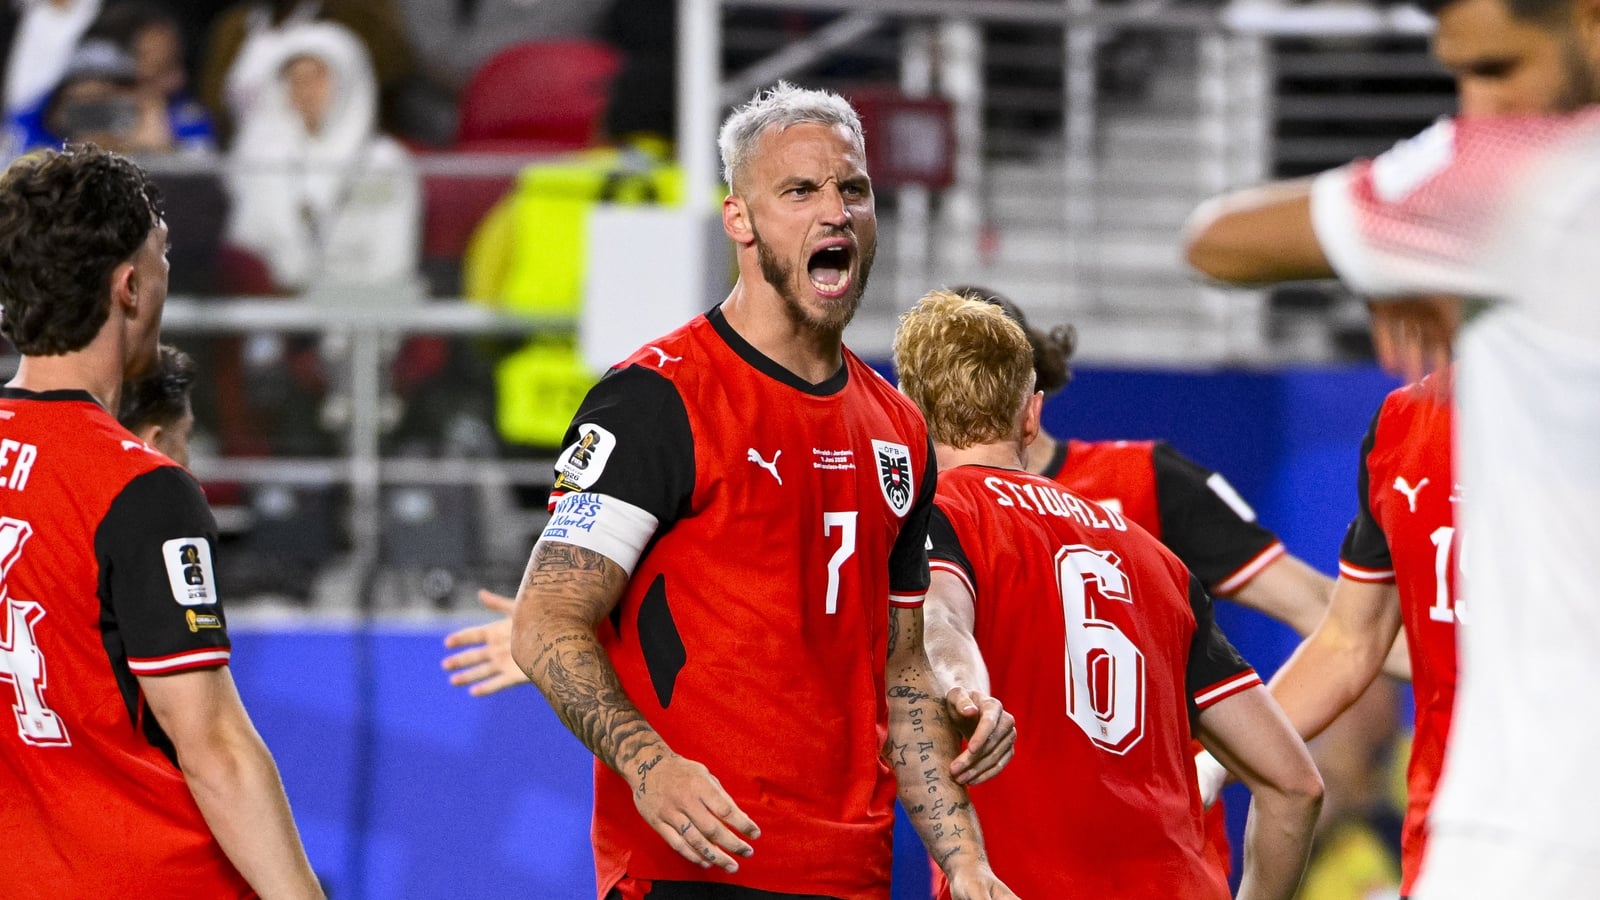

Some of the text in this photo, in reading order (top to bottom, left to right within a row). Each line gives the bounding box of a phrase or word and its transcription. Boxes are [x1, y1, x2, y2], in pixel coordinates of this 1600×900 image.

[823, 511, 858, 615] 7
[1054, 544, 1146, 755] 6
[918, 741, 934, 763] Да
